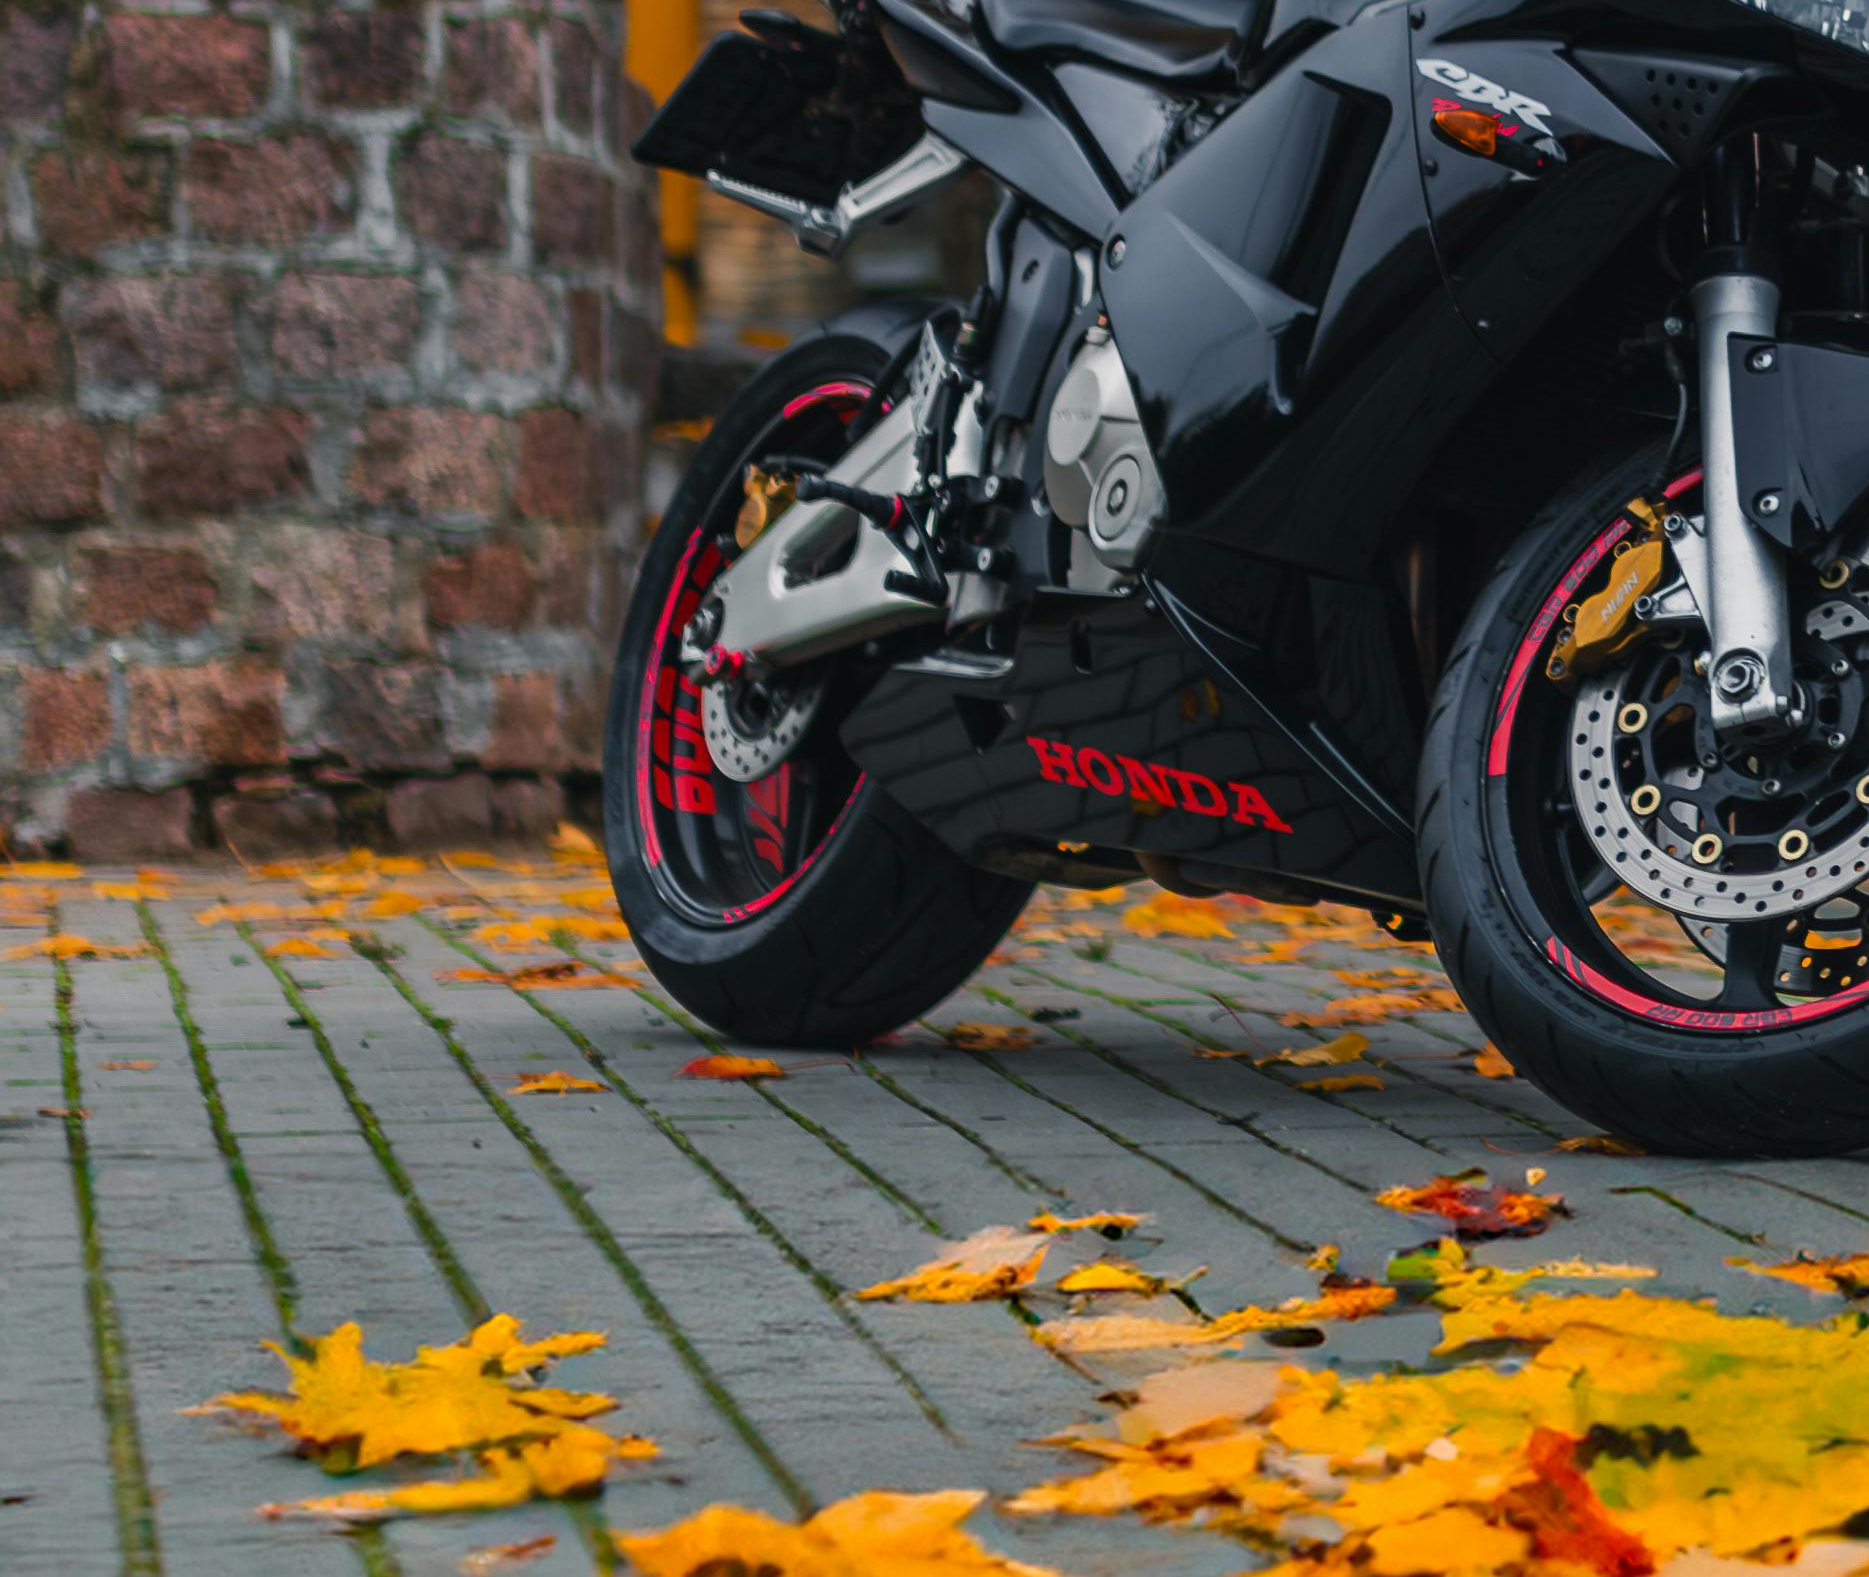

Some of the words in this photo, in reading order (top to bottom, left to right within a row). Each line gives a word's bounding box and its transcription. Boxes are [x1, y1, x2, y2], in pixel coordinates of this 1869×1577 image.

[1415, 58, 1554, 138] CBR
[1025, 734, 1294, 835] HONDA
[1645, 1004, 1684, 1021] RR
[1684, 1011, 1736, 1027] 600
[1743, 1007, 1792, 1027] CBR
